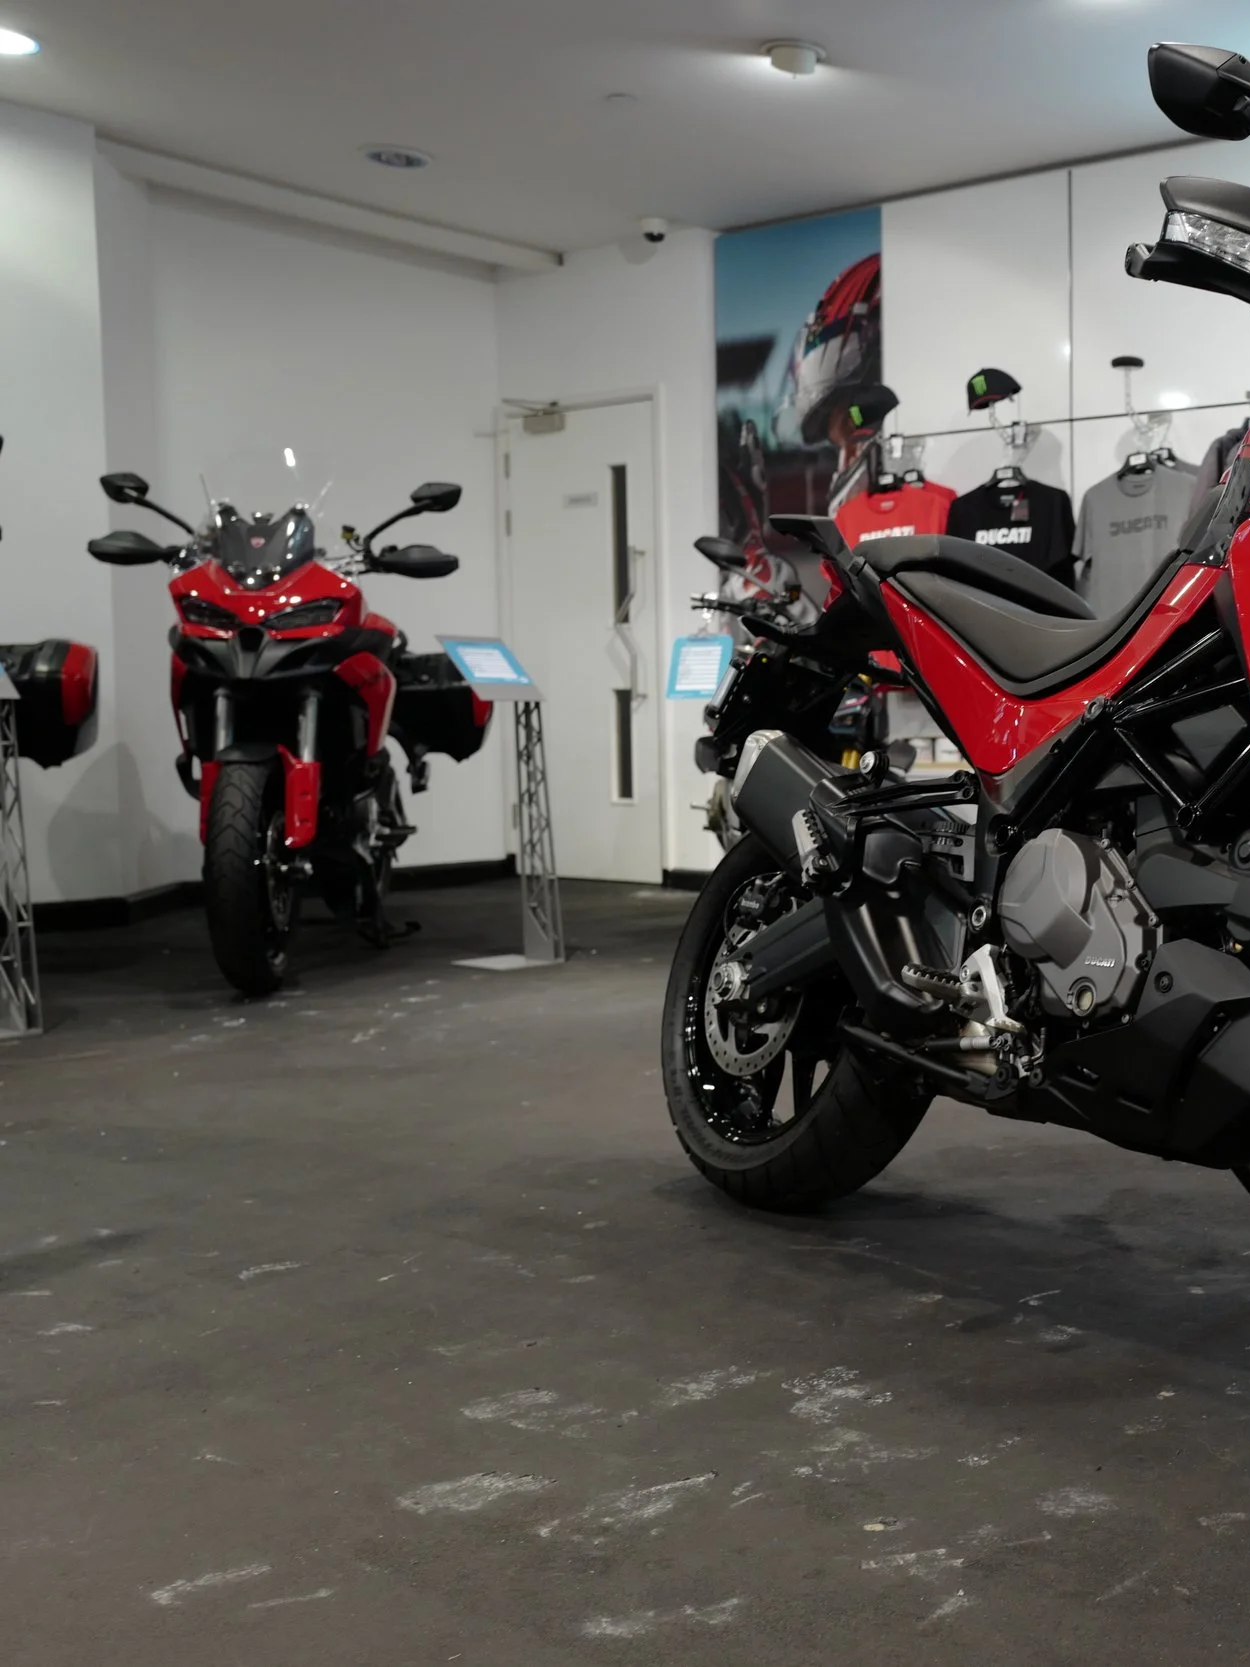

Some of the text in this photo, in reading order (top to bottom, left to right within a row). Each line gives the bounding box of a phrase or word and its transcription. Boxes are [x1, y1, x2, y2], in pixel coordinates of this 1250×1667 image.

[975, 526, 1032, 545] DUCATI
[1109, 514, 1168, 538] DUCATI
[1084, 955, 1116, 968] DUCATI
